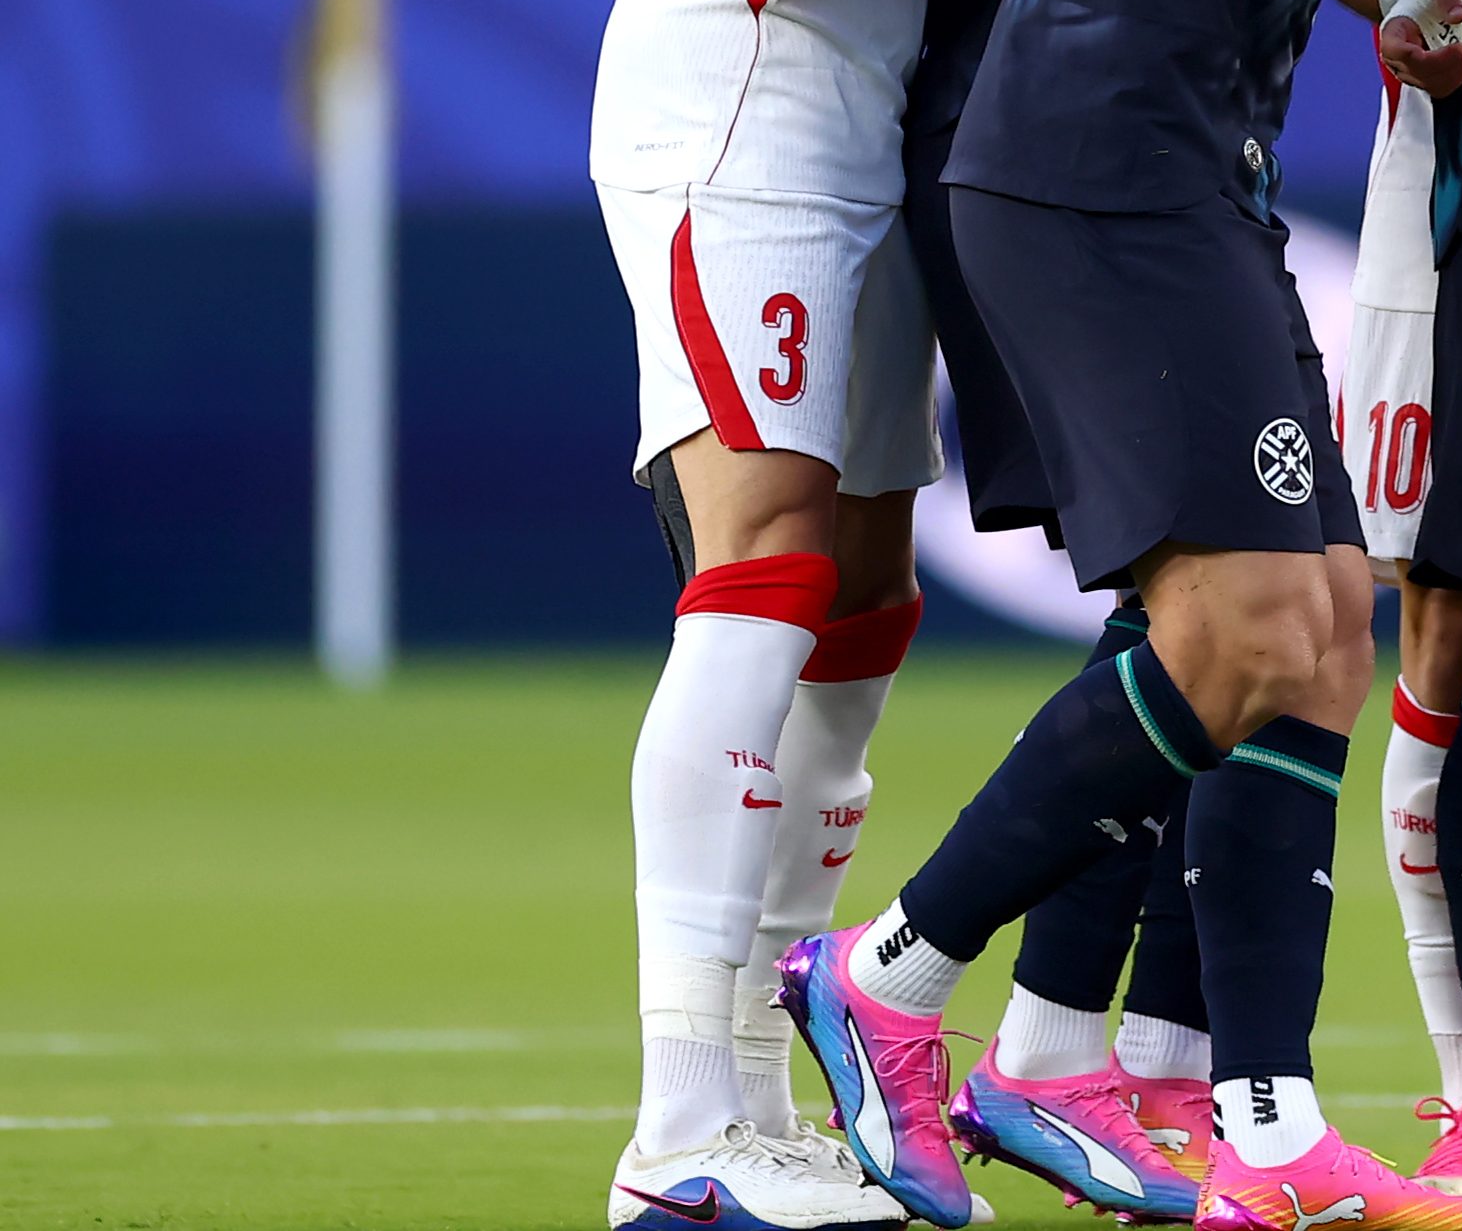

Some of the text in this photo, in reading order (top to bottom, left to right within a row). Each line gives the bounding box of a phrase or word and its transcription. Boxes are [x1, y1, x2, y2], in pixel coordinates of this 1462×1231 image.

[759, 292, 810, 407] 3
[1277, 425, 1297, 440] APF
[1365, 400, 1432, 516] 10
